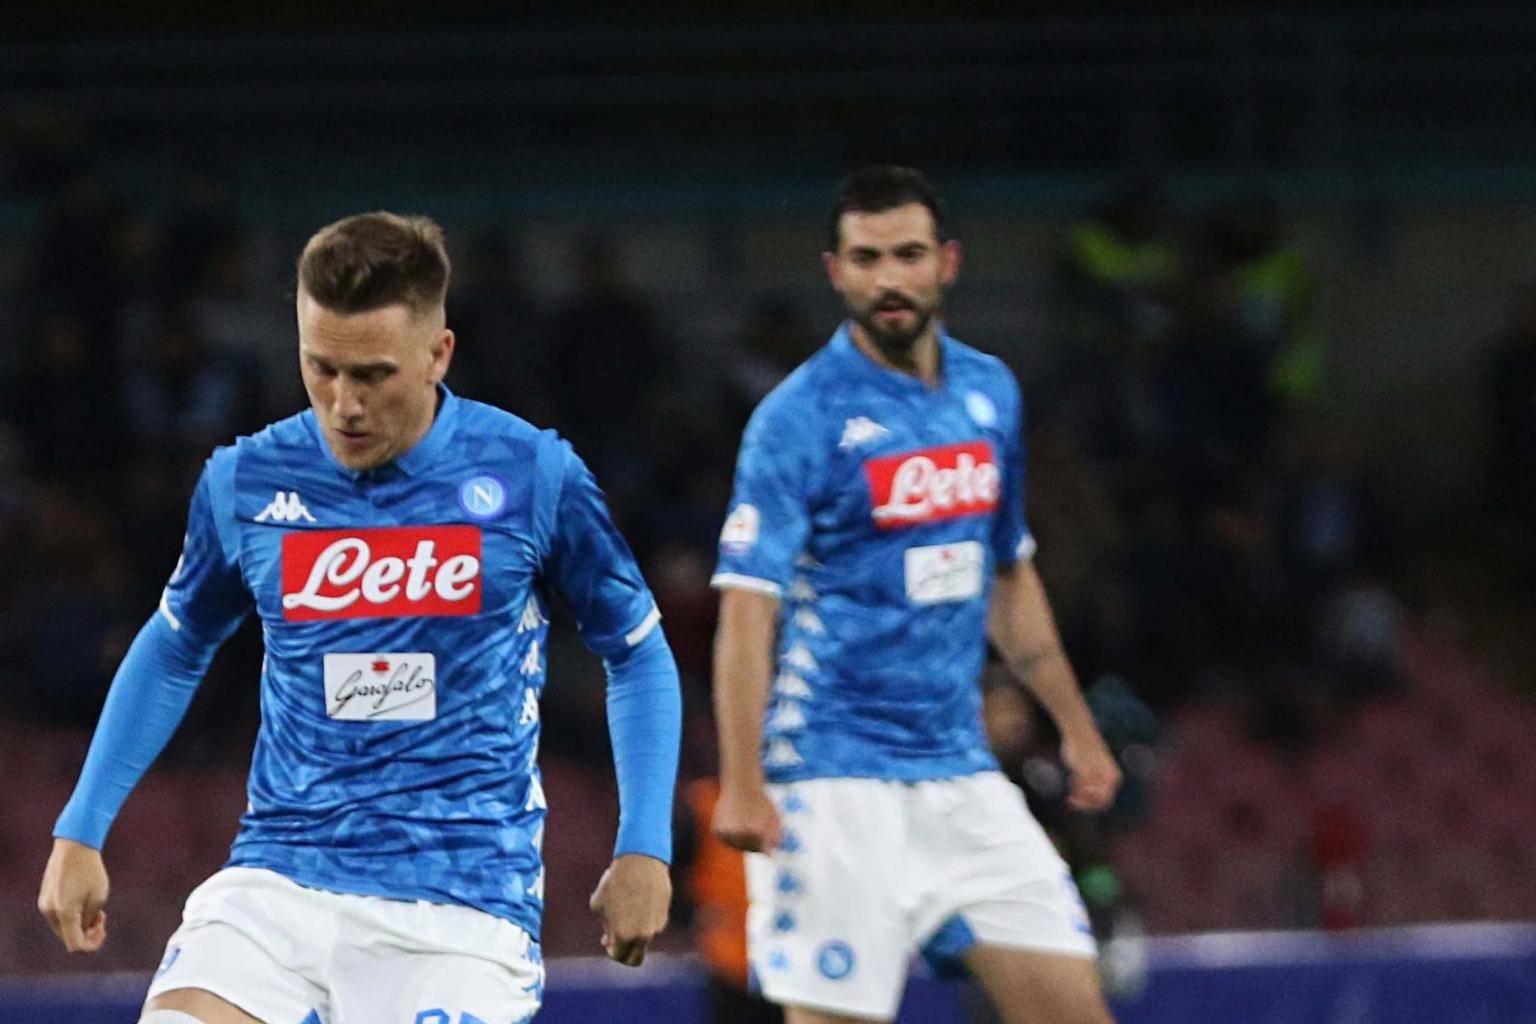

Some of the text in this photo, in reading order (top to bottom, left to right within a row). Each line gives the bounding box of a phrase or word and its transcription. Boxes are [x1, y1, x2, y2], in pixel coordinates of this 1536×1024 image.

[472, 485, 494, 509] N
[871, 451, 1002, 521] Lete
[282, 537, 480, 611] Lete
[328, 662, 434, 717] Garofalo
